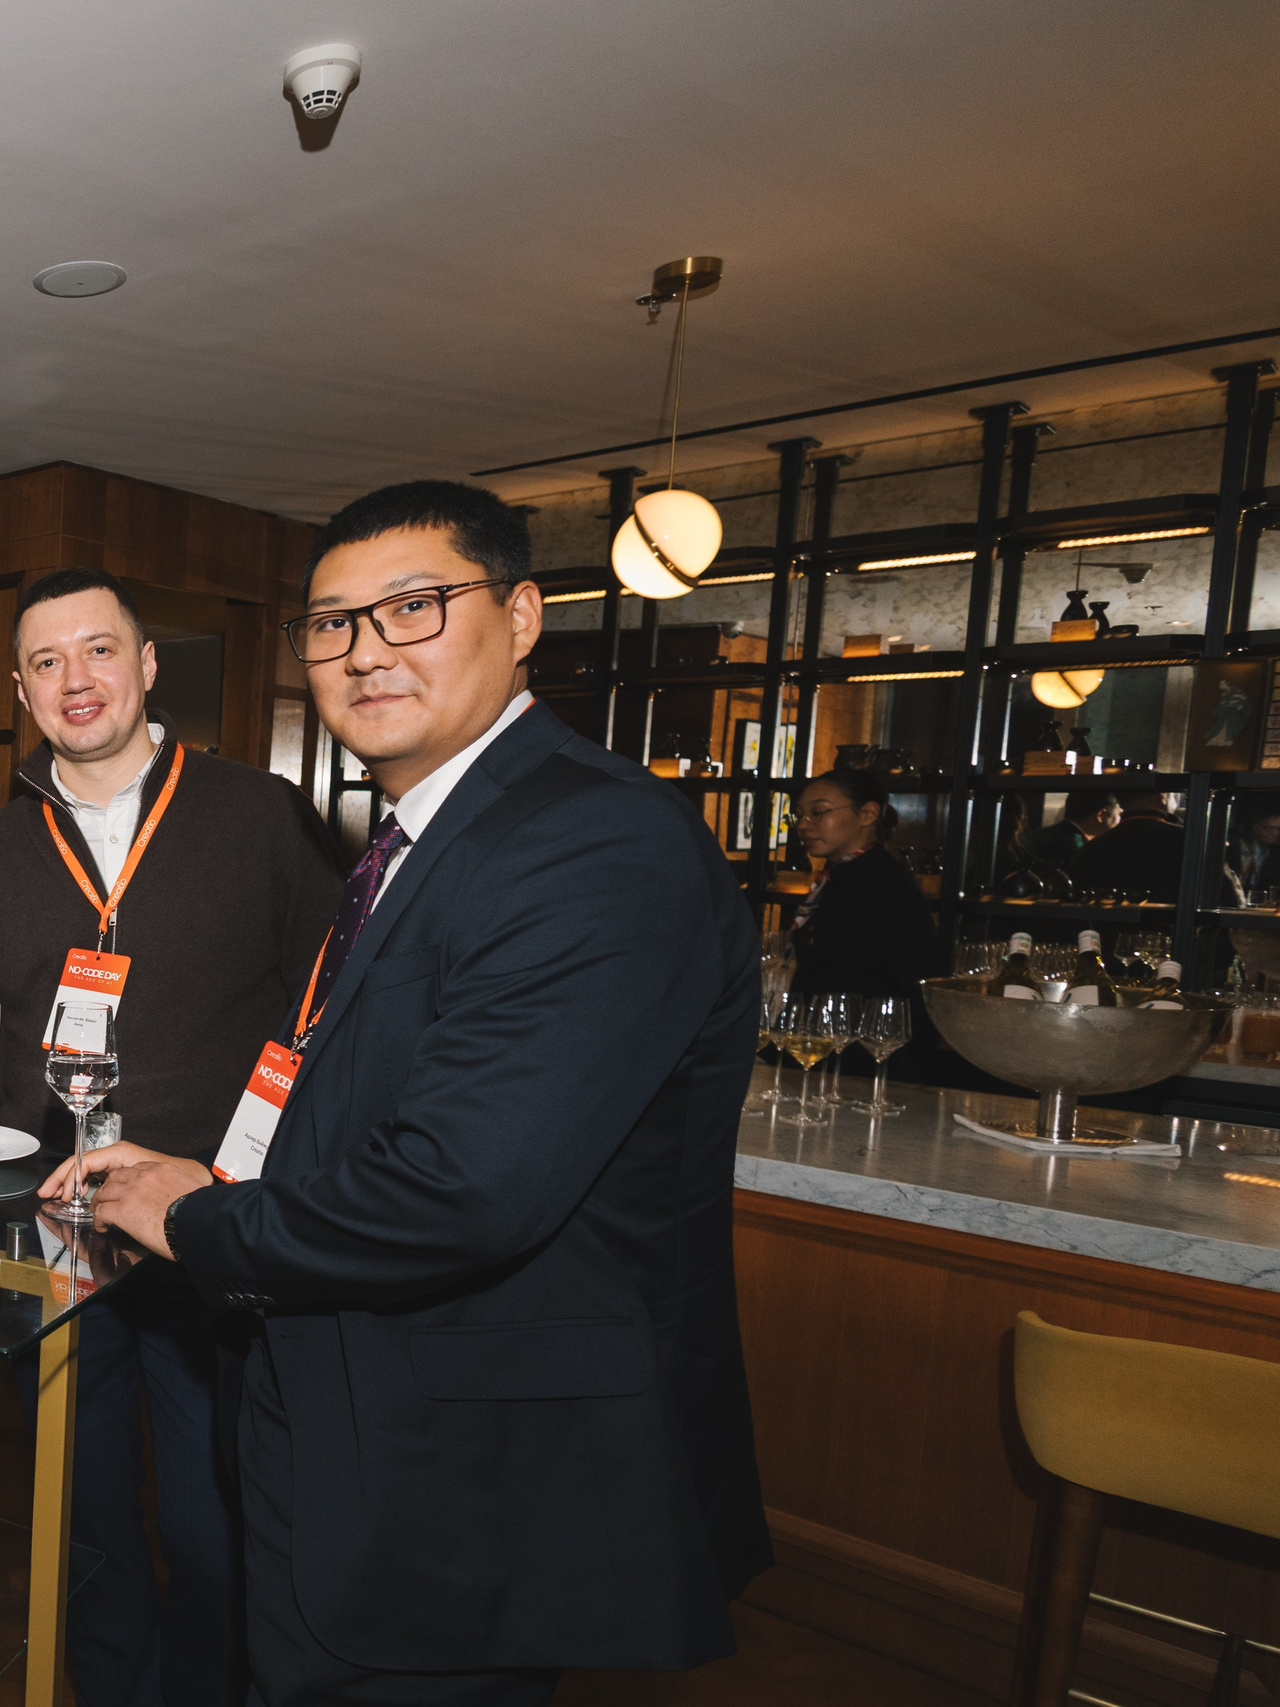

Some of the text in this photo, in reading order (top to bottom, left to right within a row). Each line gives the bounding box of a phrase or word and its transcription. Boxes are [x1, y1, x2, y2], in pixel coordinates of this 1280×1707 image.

[166, 766, 180, 791] Creatio
[52, 829, 67, 855] Creatio
[136, 818, 156, 848] Creatio
[80, 879, 99, 904] Creatio
[108, 878, 127, 907] Creatio
[72, 953, 87, 961] Creatio
[68, 965, 122, 982] NO-CODE DAY
[266, 1049, 282, 1062] Creatio
[262, 1080, 273, 1089] THE
[274, 1086, 285, 1096] AGE
